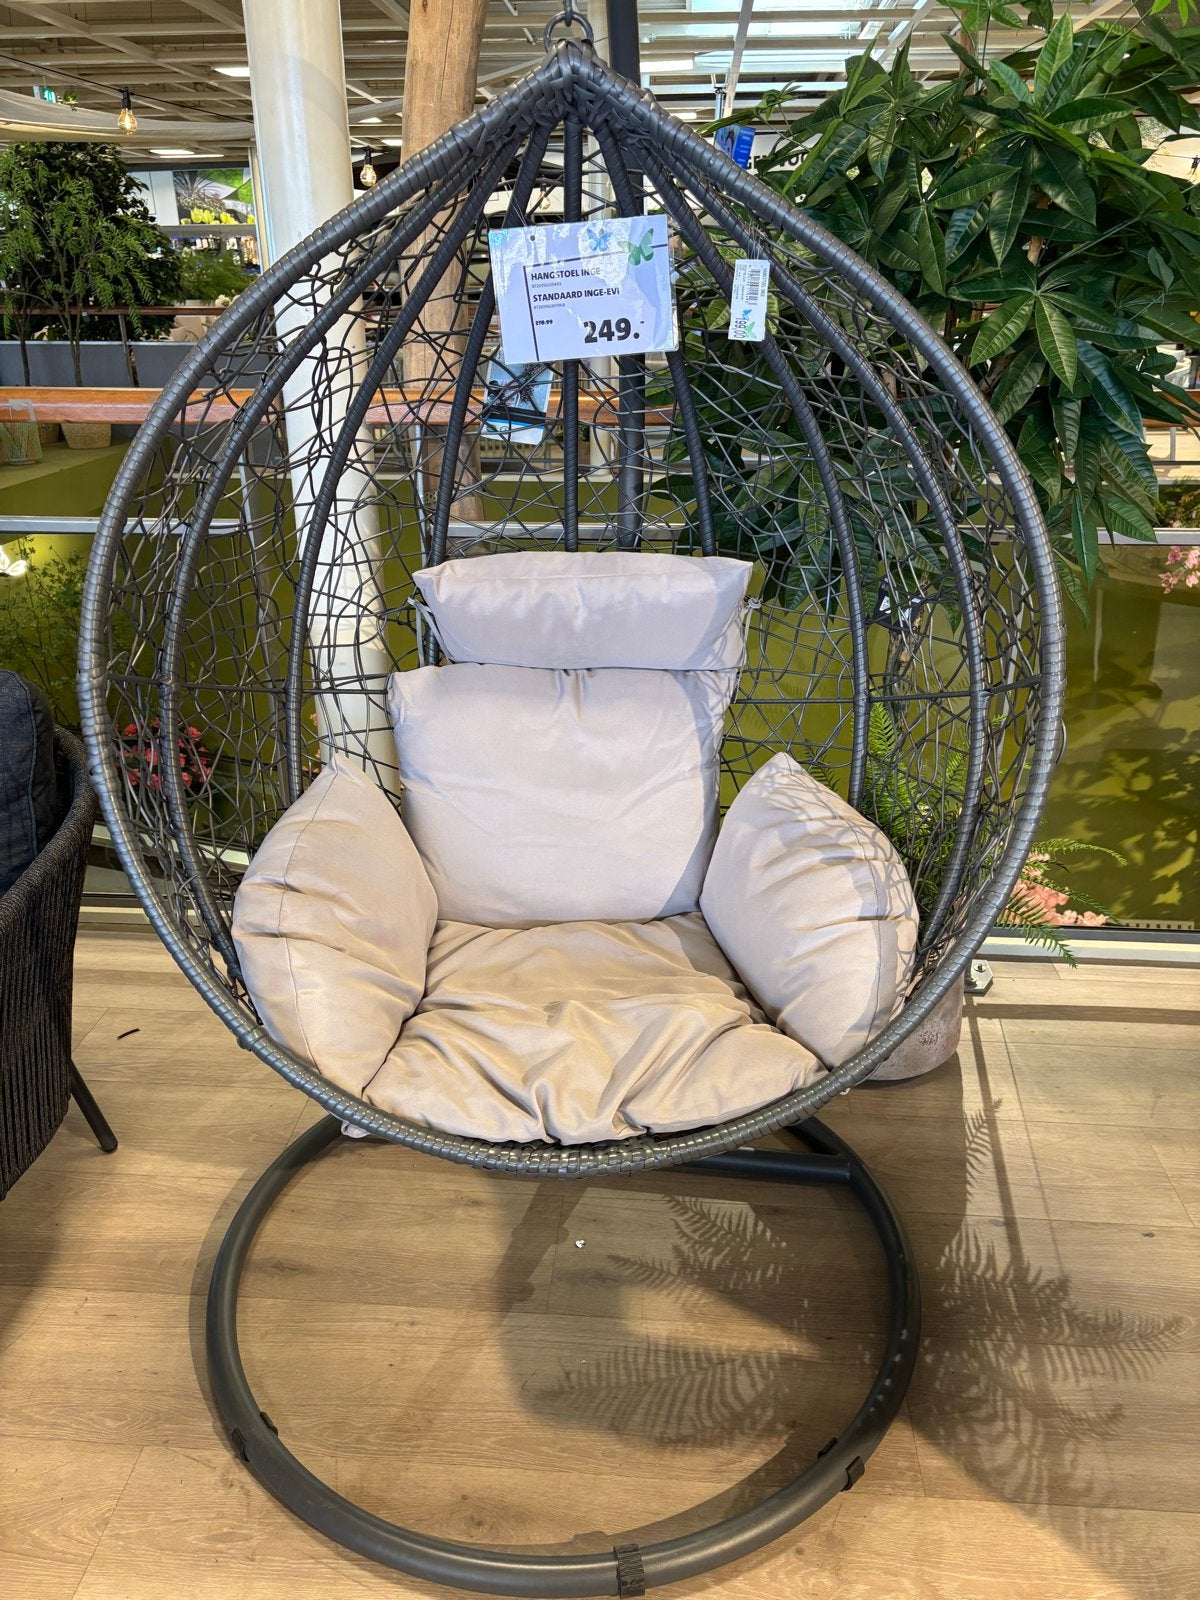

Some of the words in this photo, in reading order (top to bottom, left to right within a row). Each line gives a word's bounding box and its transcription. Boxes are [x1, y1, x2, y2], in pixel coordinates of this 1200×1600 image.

[531, 269, 579, 281] HANGSTOEL
[581, 267, 601, 277] INGE
[533, 290, 583, 302] STANDAARD
